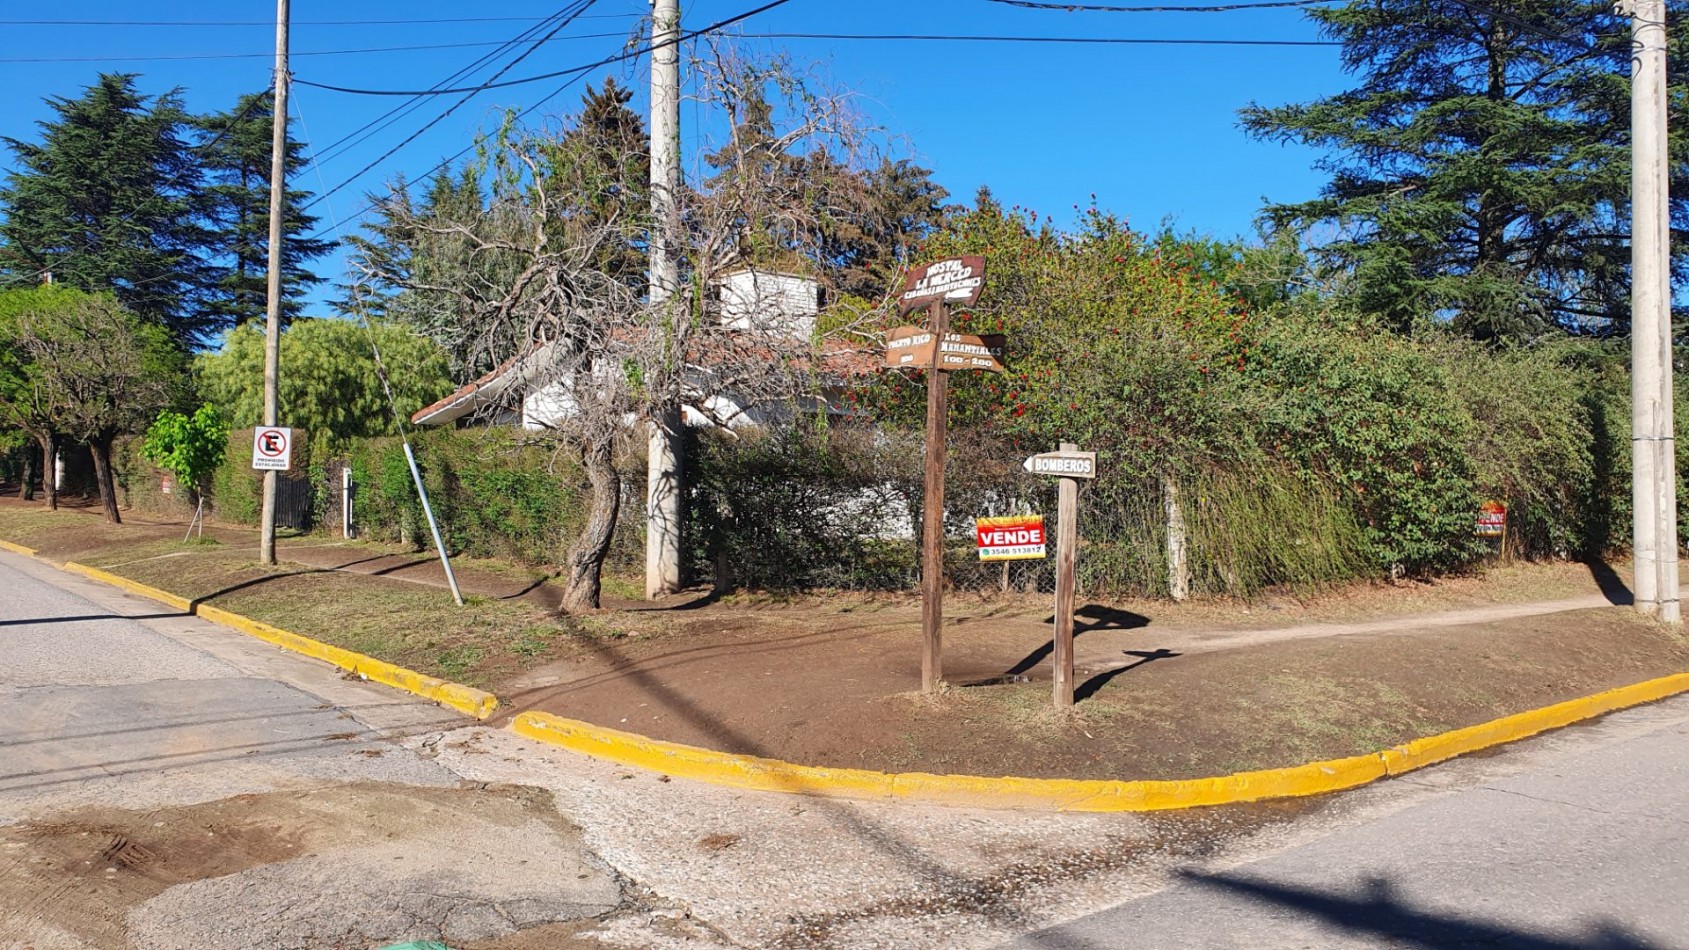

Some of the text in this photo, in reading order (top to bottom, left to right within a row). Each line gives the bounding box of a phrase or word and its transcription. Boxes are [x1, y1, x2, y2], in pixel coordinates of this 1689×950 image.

[926, 259, 963, 278] HOSTAL
[915, 266, 972, 290] LA MERCED
[912, 333, 931, 346] RICO
[943, 355, 963, 364] 100
[971, 357, 993, 367] 200
[1035, 458, 1091, 473] BOMBEROS
[980, 529, 1041, 545] VENDE
